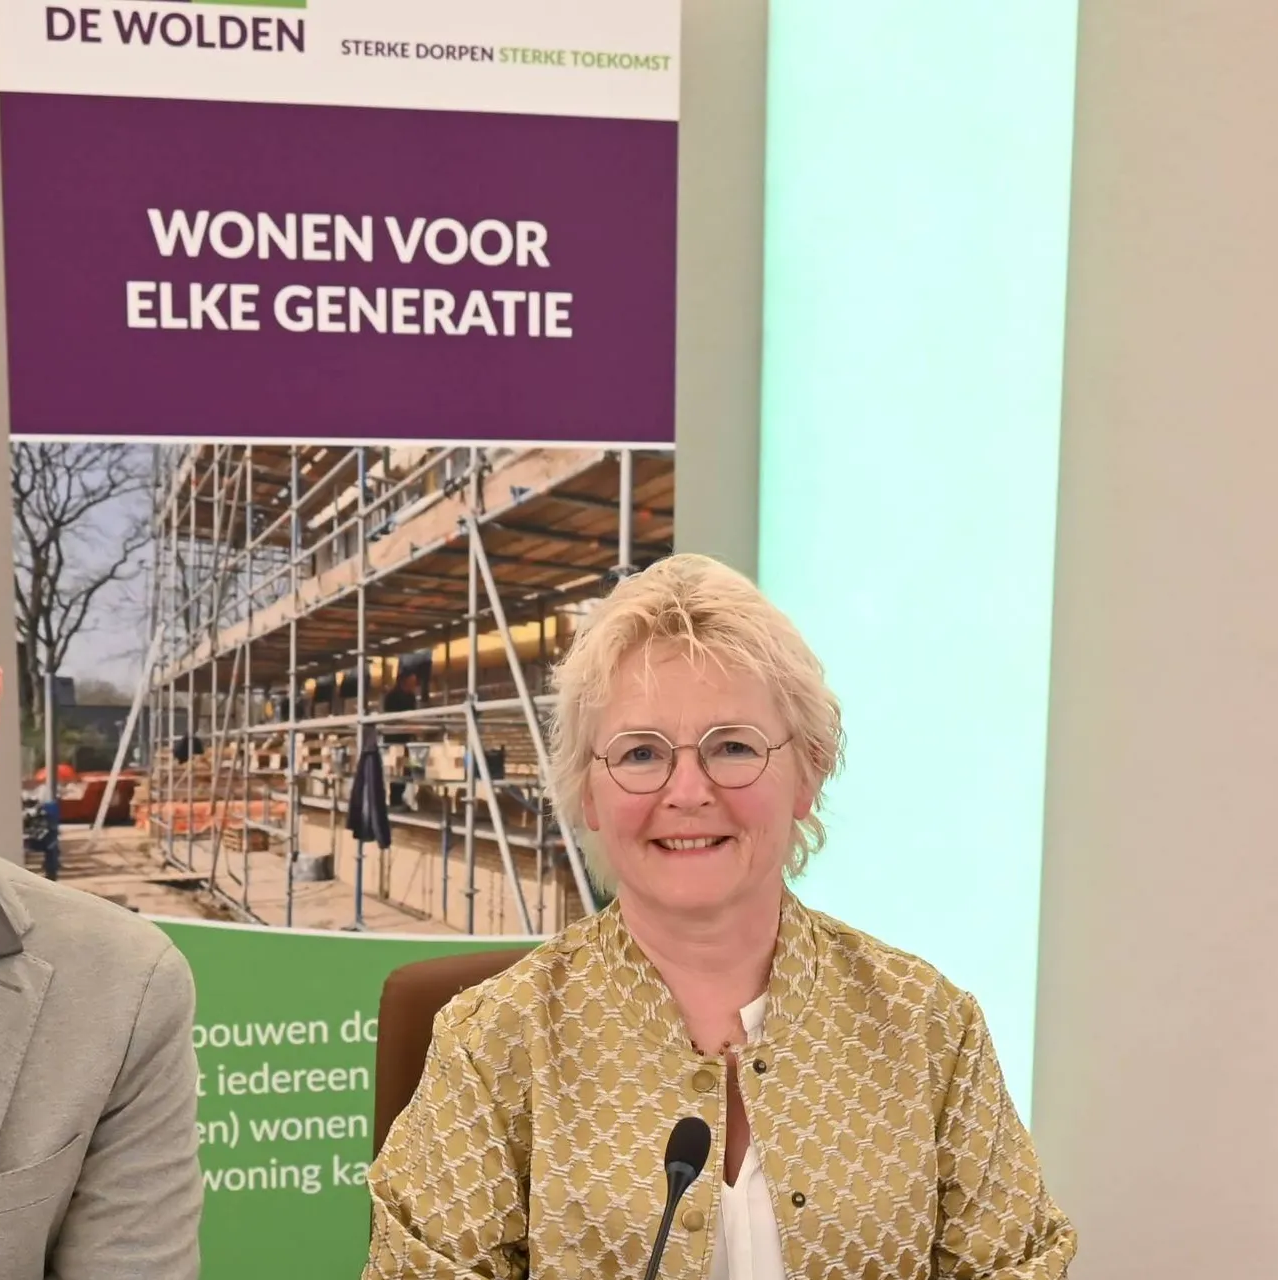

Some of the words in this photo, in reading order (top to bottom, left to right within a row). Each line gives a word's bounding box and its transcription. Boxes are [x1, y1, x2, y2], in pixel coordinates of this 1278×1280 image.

[45, 7, 102, 44] DE
[113, 9, 306, 53] WOLDEN
[341, 39, 410, 58] STERKE
[416, 43, 494, 63] DORPEN
[499, 46, 566, 66] STERKE
[570, 51, 671, 71] TOEKOMST
[147, 208, 373, 262] WONEN
[385, 217, 550, 267] VOOR
[126, 280, 260, 331] ELKE
[273, 284, 573, 338] GENERATIE
[217, 1062, 369, 1096] iedereen
[249, 1114, 368, 1143] wonen
